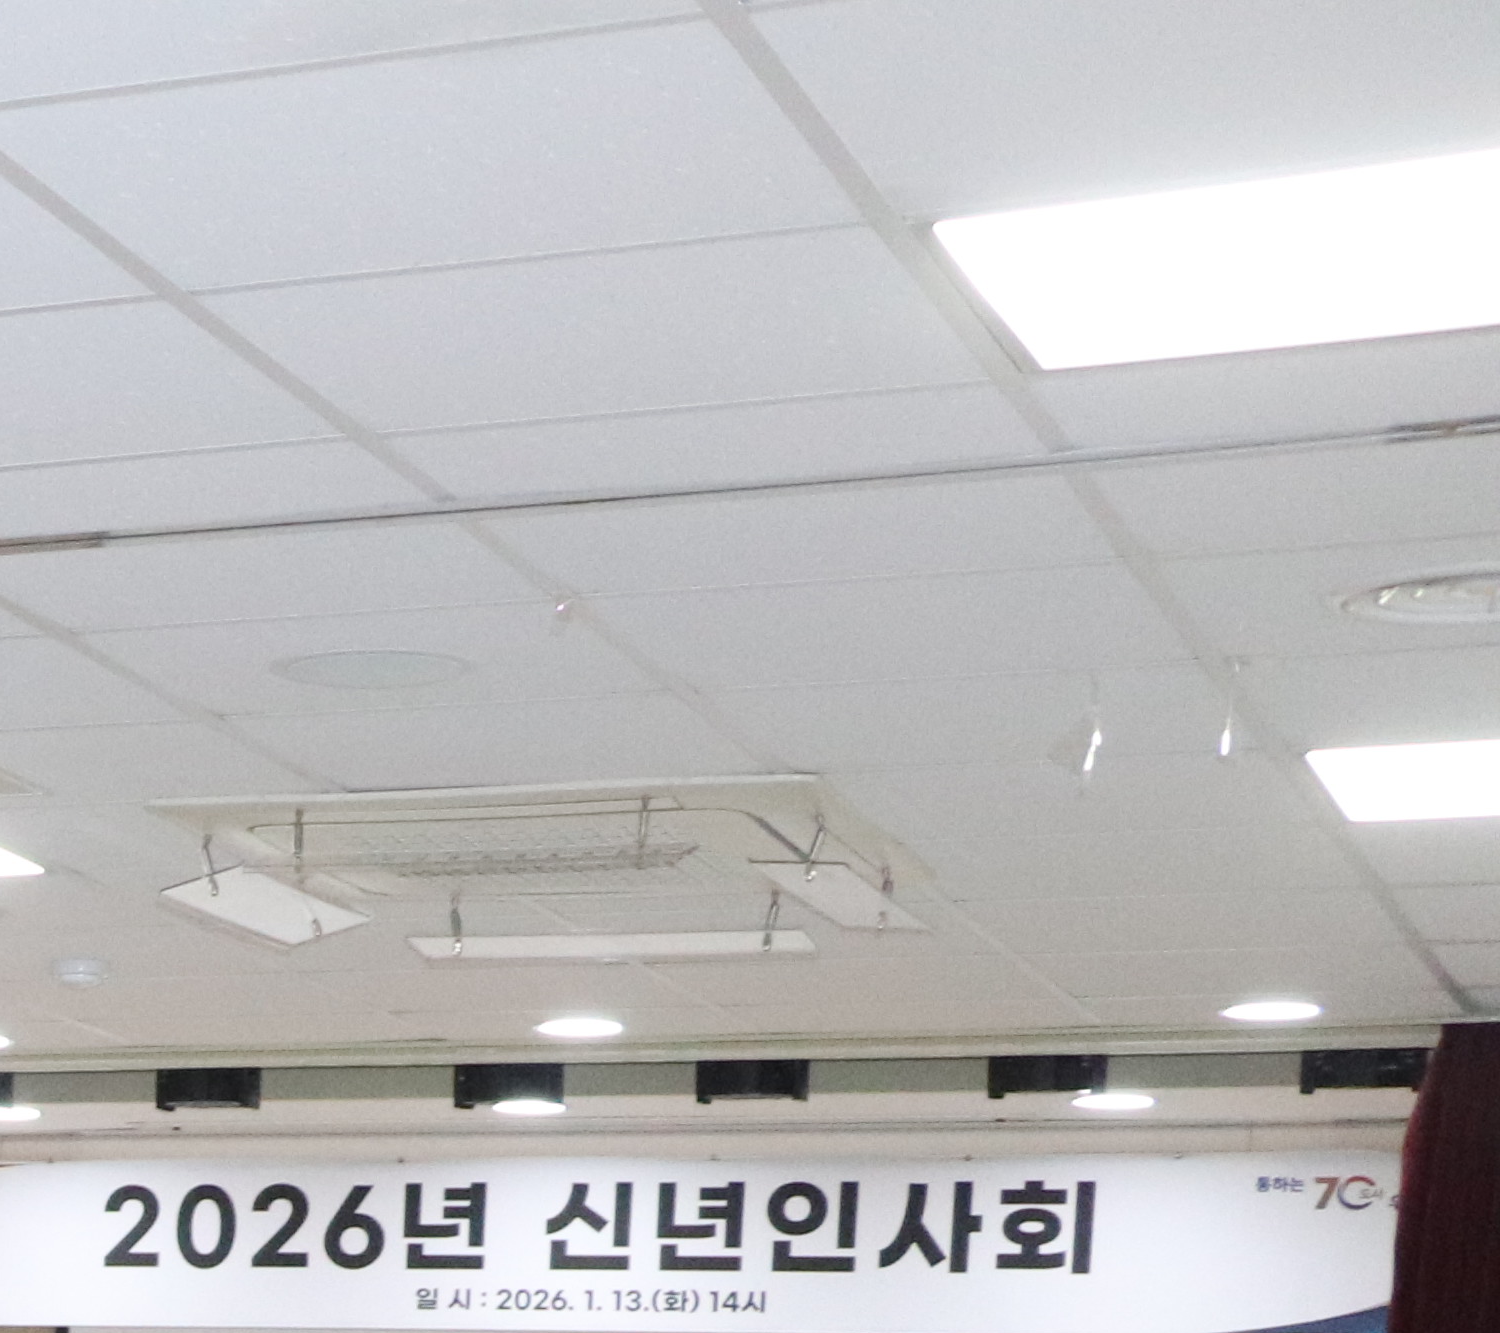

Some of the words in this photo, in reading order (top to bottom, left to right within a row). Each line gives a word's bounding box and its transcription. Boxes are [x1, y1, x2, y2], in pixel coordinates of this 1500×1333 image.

[103, 1181, 489, 1270] 2026년
[544, 1180, 1097, 1276] 신년인사회
[495, 1288, 574, 1312] 2026.
[584, 1289, 602, 1312] 1.
[612, 1288, 700, 1314] 13.(화)
[709, 1289, 767, 1314] 14시
